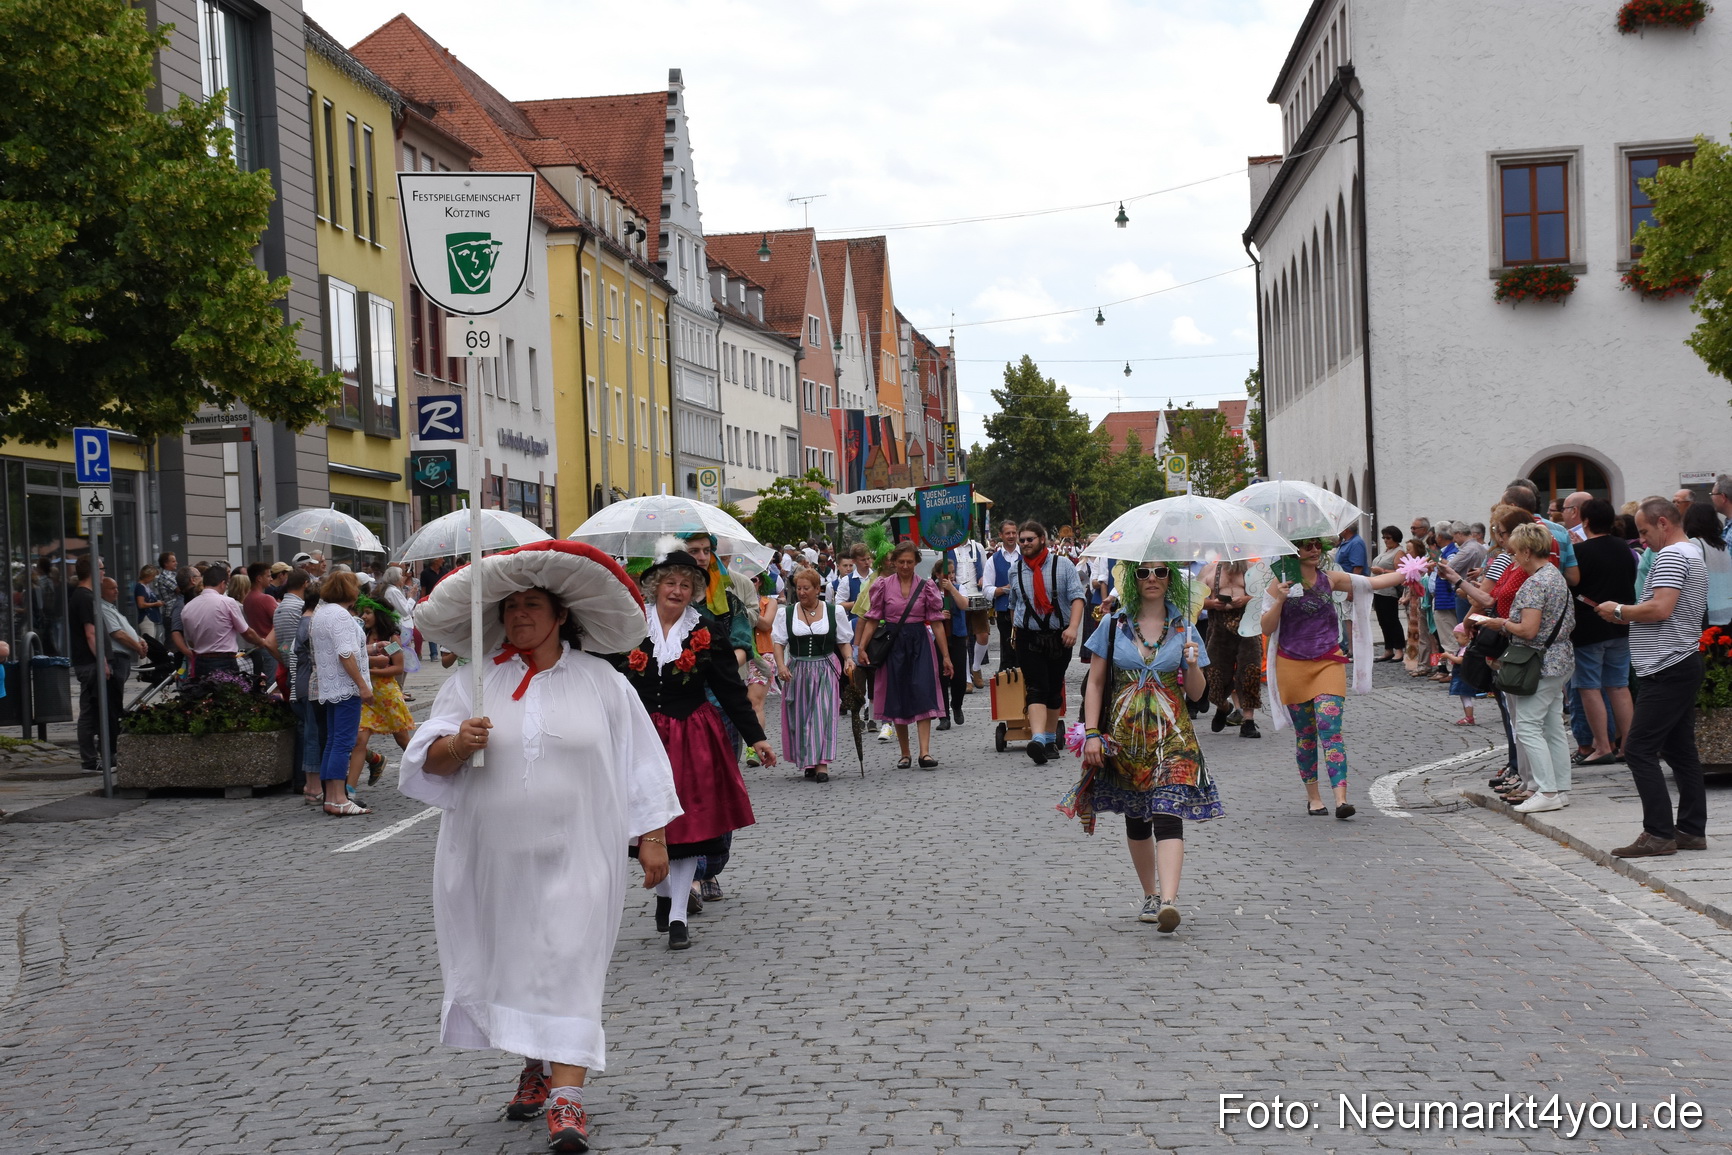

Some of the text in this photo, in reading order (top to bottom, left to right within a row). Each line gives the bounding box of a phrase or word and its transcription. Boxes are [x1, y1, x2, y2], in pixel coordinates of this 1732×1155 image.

[466, 330, 490, 349] 69
[82, 435, 102, 476] P
[944, 424, 956, 478] HOTE
[922, 489, 951, 501] JUGEND-
[925, 494, 967, 509] BLASKAPELLE
